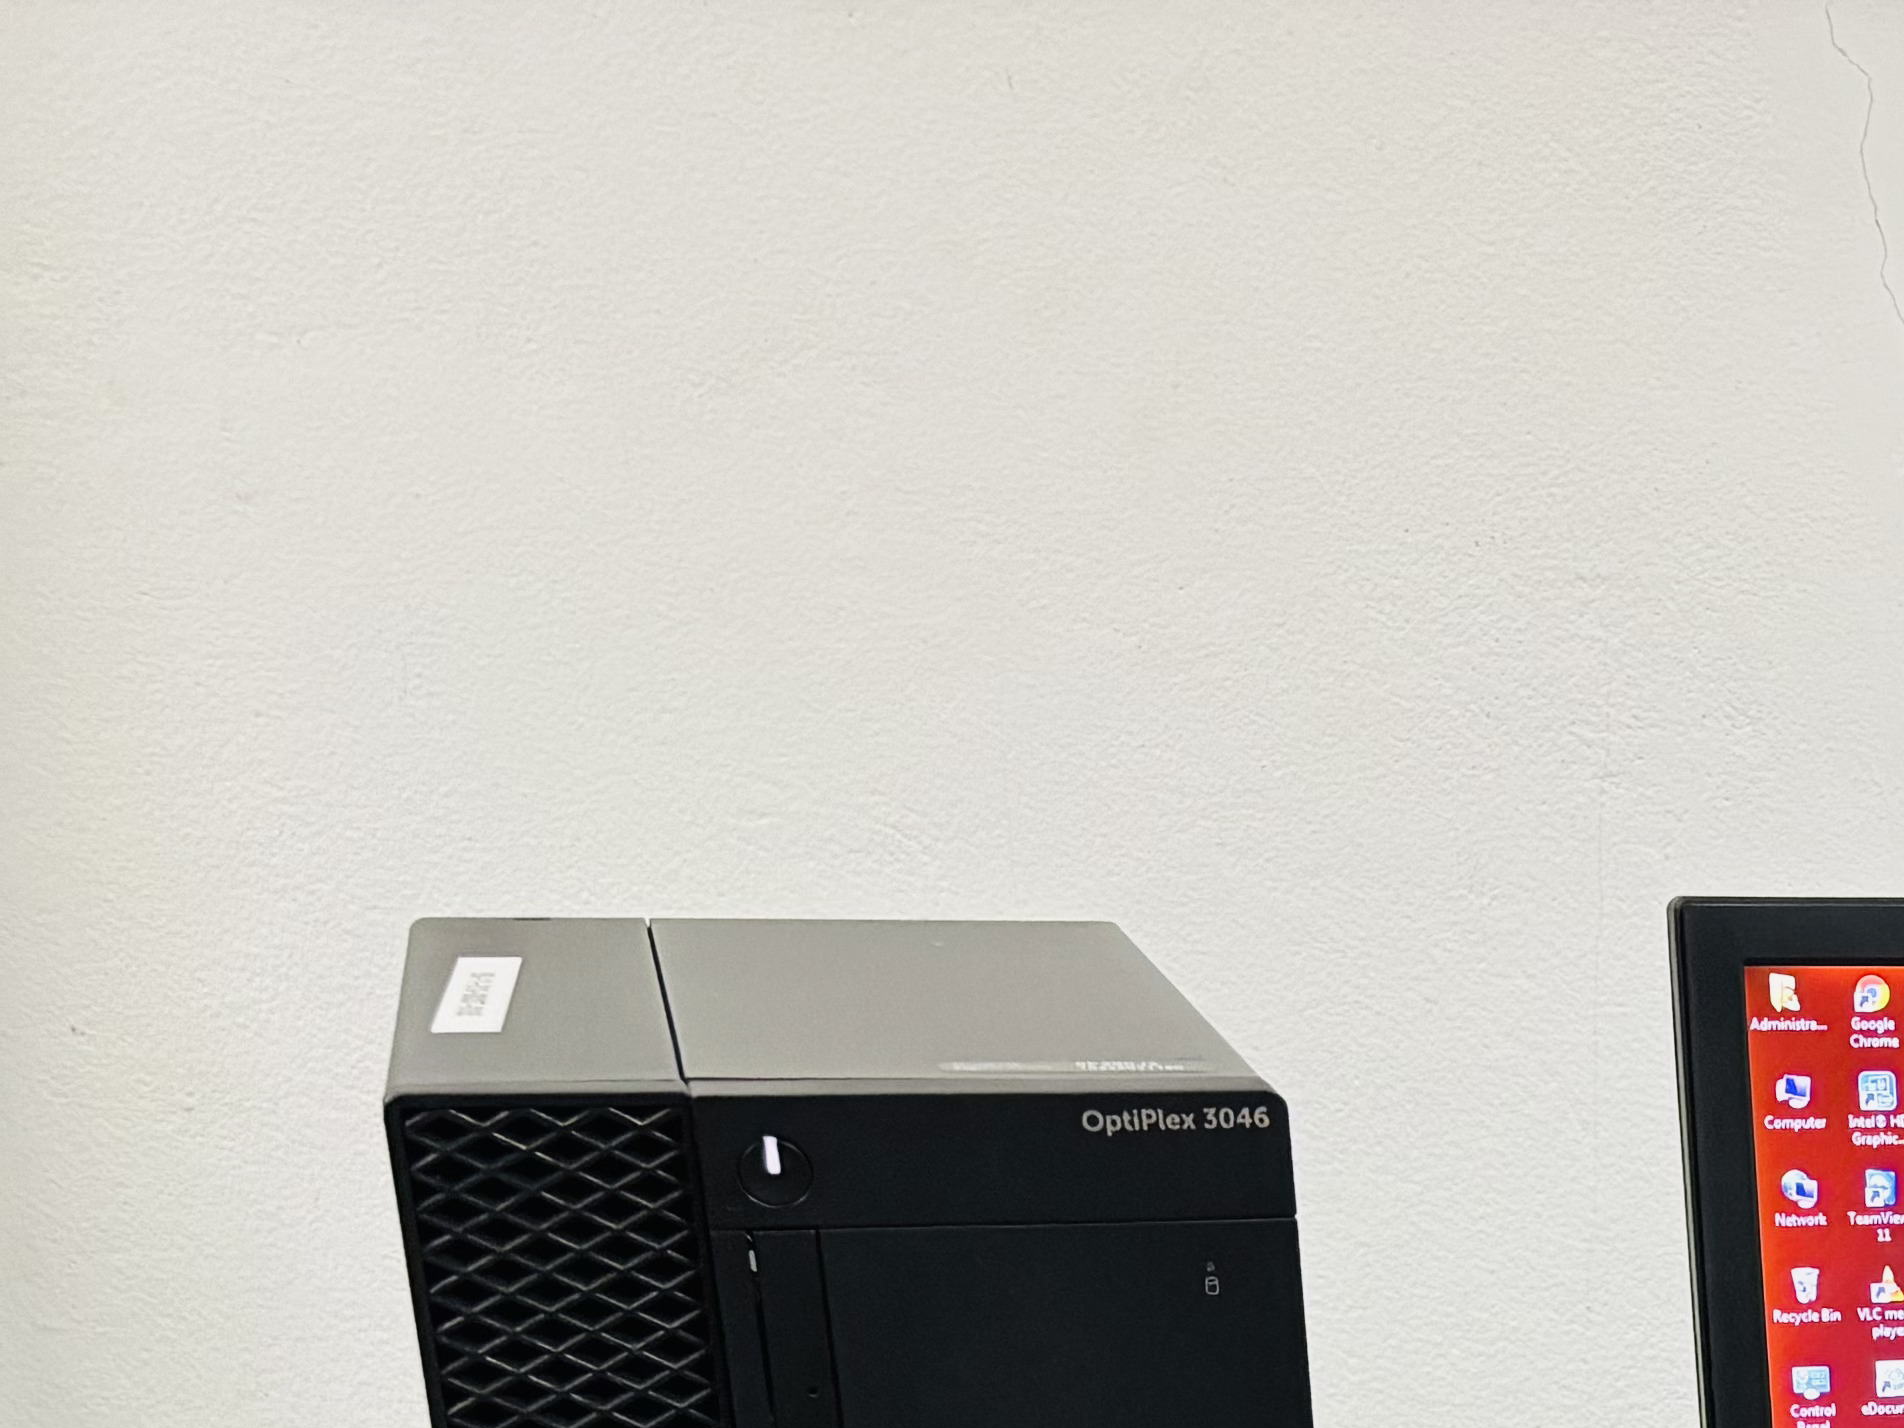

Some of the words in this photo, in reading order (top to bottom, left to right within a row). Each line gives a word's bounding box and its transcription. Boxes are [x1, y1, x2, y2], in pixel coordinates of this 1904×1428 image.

[1851, 1017, 1896, 1034] Google
[1850, 1035, 1900, 1049] Chrome
[1081, 1108, 1197, 1136] OptiPlex
[1202, 1106, 1271, 1129] 3046
[1764, 1115, 1827, 1132] Computer
[1774, 1212, 1828, 1227] Network
[1877, 1229, 1892, 1242] 11
[1773, 1309, 1820, 1326] Recycle
[1821, 1308, 1842, 1322] Bin
[1857, 1307, 1882, 1321] VLC
[1790, 1403, 1837, 1418] Control
